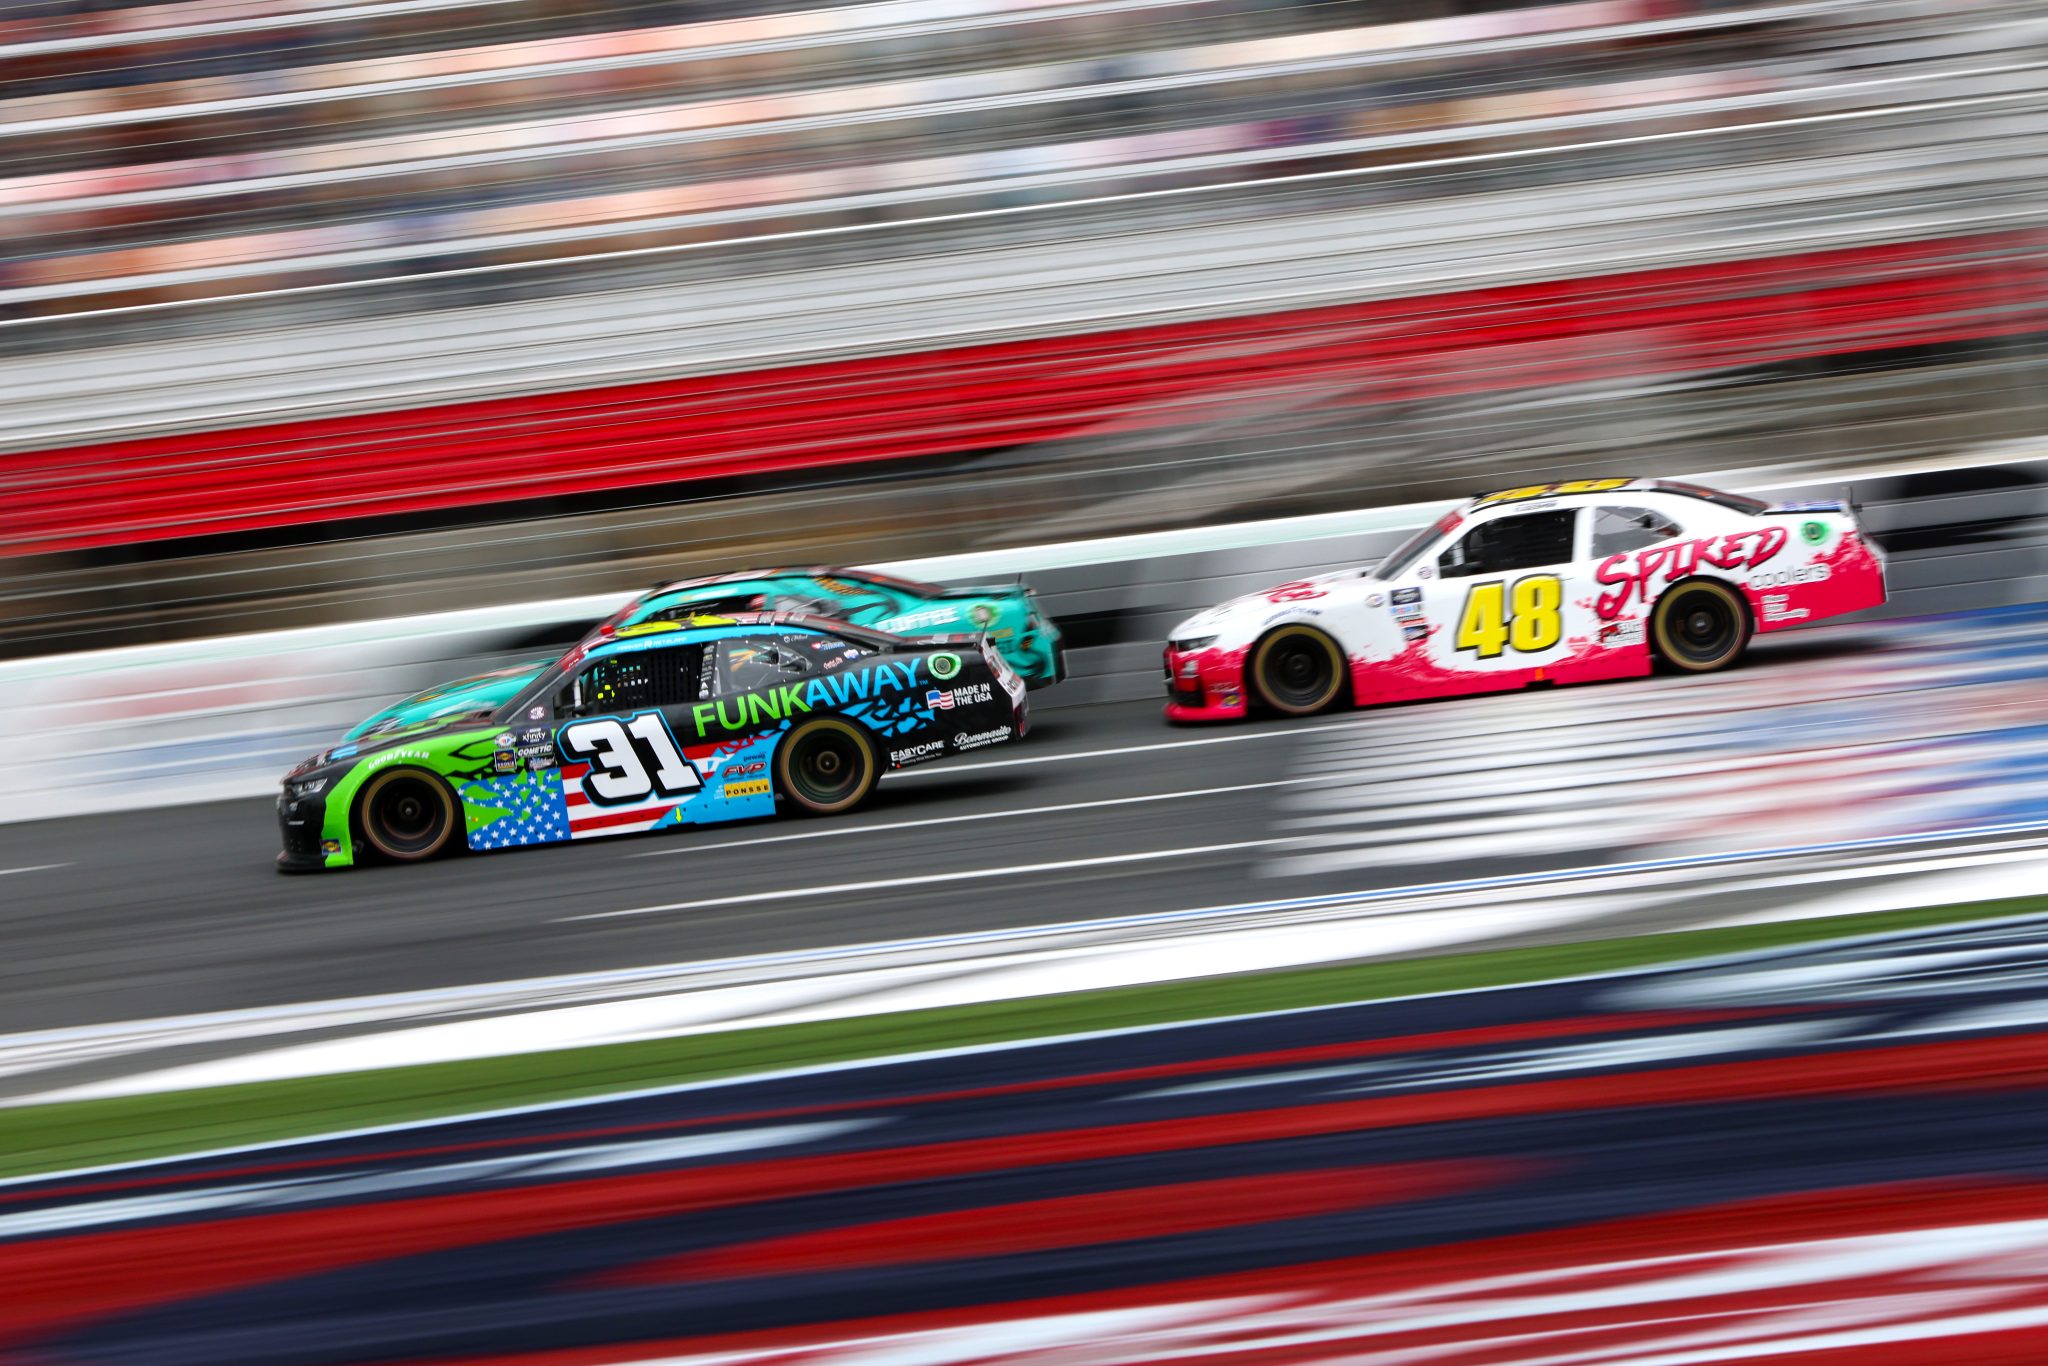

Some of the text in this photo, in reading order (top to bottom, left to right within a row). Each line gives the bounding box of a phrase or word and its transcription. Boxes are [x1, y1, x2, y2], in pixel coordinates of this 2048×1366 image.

[1596, 527, 1786, 620] SPIKED
[1750, 565, 1827, 588] coolers
[1455, 573, 1562, 660] 48
[692, 657, 922, 737] FUNKAWAY
[954, 682, 991, 697] MADE IN
[954, 693, 993, 706] THE USA
[564, 711, 703, 803] 31
[890, 740, 945, 761] EASYCARE
[726, 784, 769, 796] PONSSE
